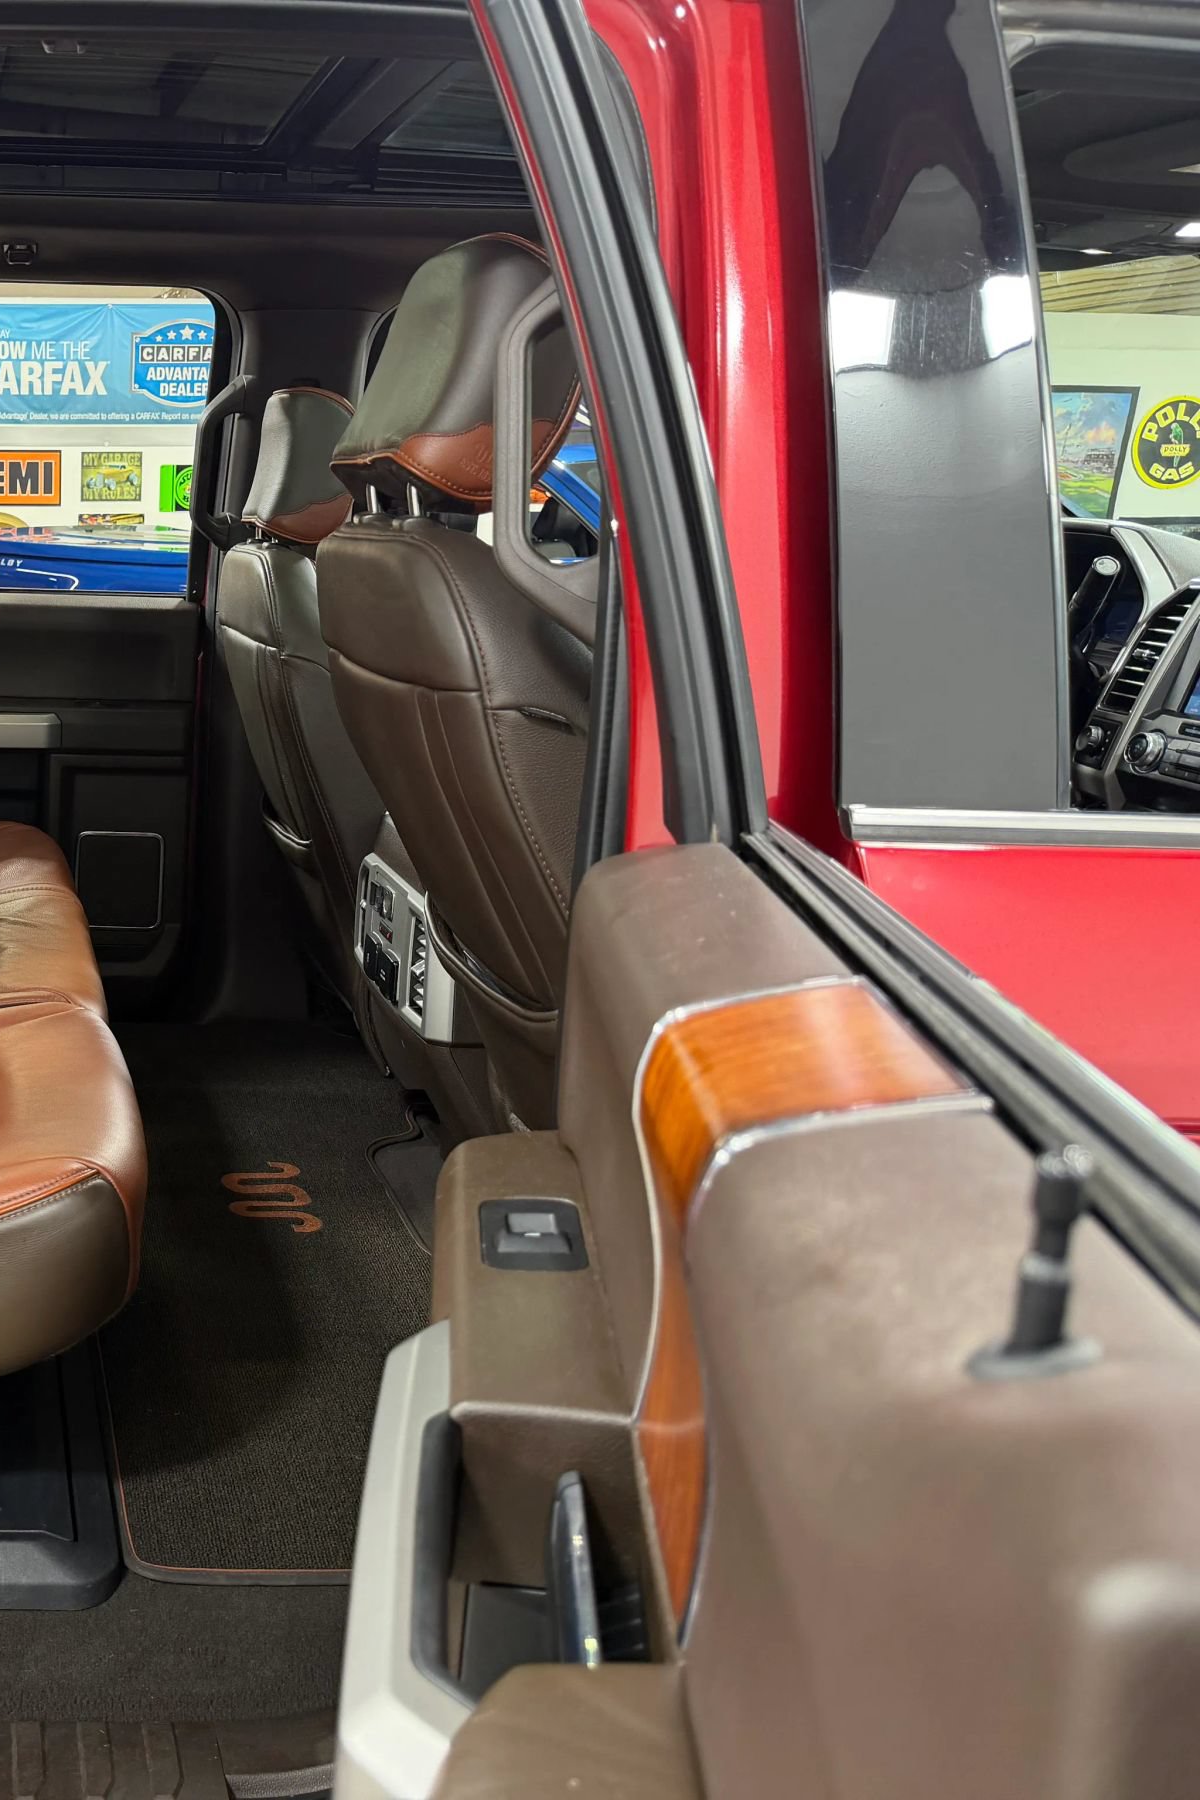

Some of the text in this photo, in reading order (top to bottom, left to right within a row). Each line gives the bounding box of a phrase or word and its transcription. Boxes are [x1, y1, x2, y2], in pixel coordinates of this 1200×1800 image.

[31, 340, 56, 360] ME
[59, 340, 91, 360] THE
[142, 347, 212, 361] CARFA
[146, 366, 209, 381] ADVANTA
[70, 411, 99, 420] committed
[161, 412, 181, 421] Report
[1141, 403, 1200, 442] POLL
[83, 453, 140, 466] MY GARAGE
[1148, 461, 1194, 481] GAS
[83, 487, 140, 500] MY RULES!
